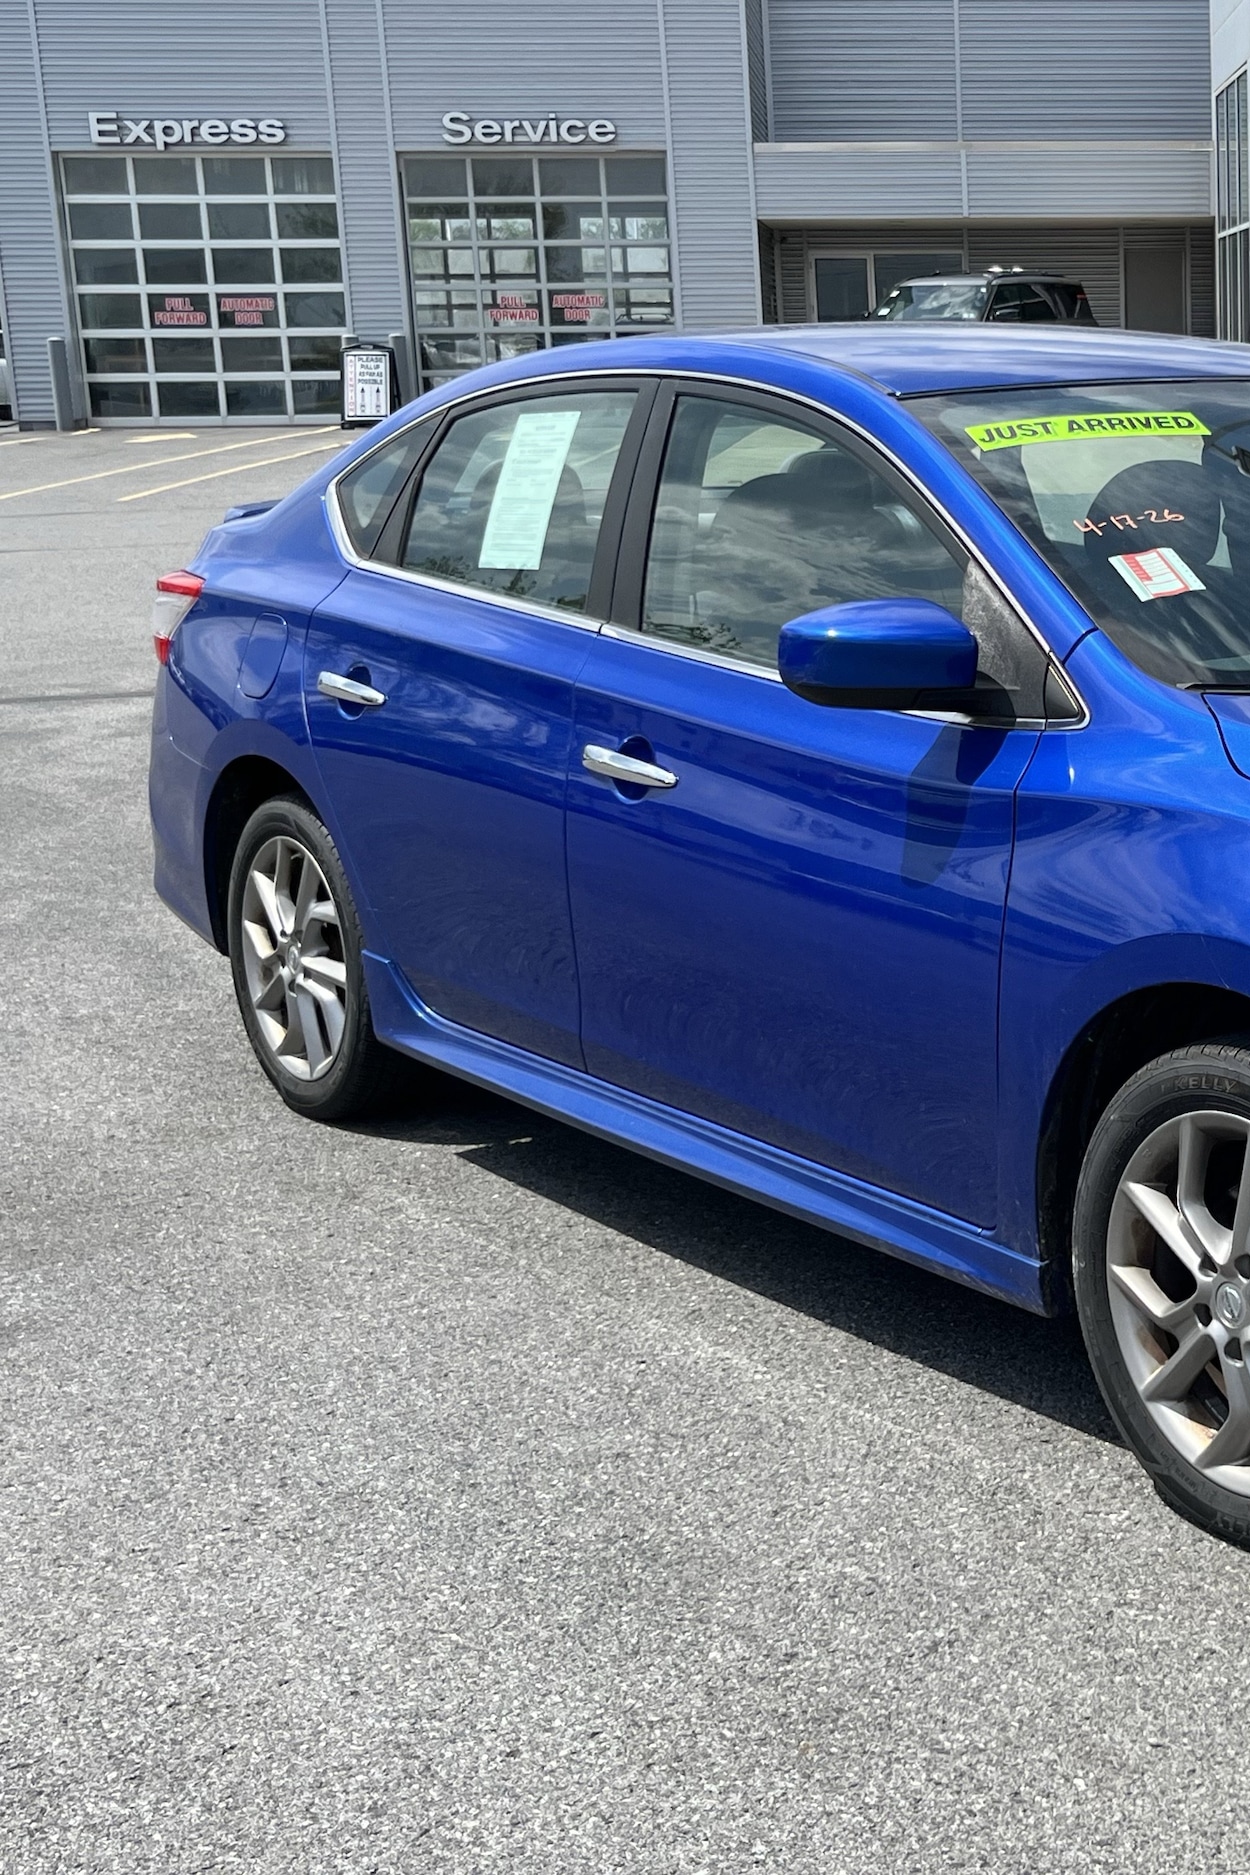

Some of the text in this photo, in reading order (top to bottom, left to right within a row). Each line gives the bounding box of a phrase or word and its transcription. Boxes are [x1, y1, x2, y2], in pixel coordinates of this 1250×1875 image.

[87, 111, 287, 151] Express
[441, 111, 617, 144] Service
[165, 297, 194, 311] PULL
[220, 297, 275, 311] AUTOMATIC
[500, 296, 526, 308] PULL
[552, 294, 605, 308] AUTOMATIC
[154, 311, 207, 325] FORWARD
[234, 311, 264, 325] DOOR
[488, 308, 540, 321] FORWARD
[564, 308, 592, 321] DOOR
[978, 415, 1195, 443] JUST ARRIVED
[1073, 508, 1185, 536] 4-17-26
[1174, 1075, 1237, 1094] KELLY
